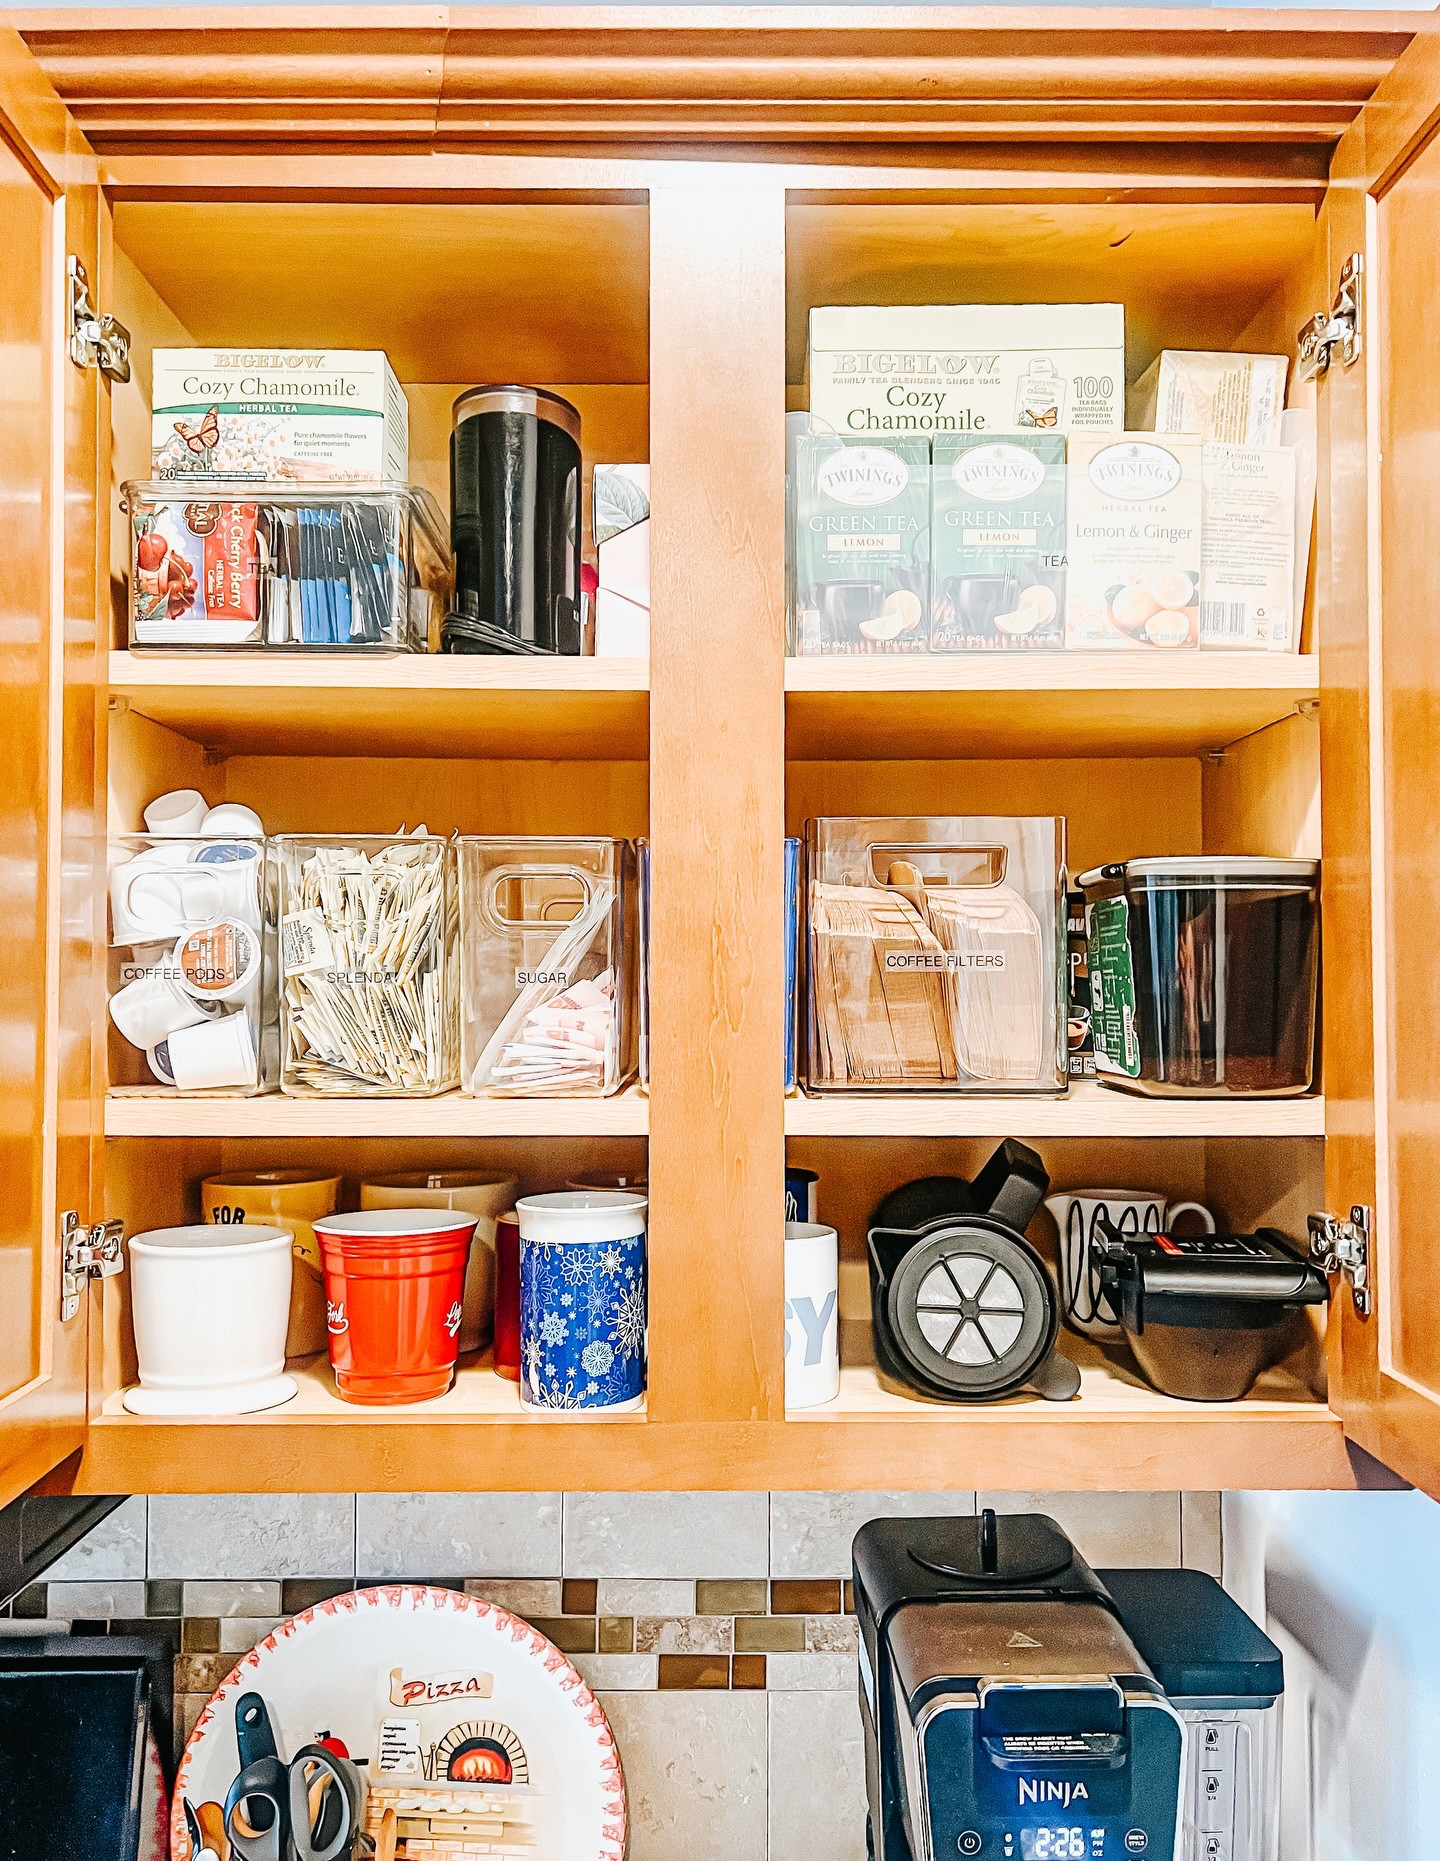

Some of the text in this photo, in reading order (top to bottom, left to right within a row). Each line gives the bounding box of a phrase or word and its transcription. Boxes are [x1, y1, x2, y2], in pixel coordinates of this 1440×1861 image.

[214, 354, 325, 368] BIGELOW
[832, 354, 1001, 374] BIGELOW
[183, 377, 357, 400] Cozy Chamomile
[1072, 376, 1114, 398] 100
[886, 385, 947, 413] Cozy
[239, 404, 298, 413] HERBAL TEA
[846, 408, 985, 430] Chamomile
[344, 432, 367, 440] flowers
[160, 468, 176, 480] 20
[960, 464, 1040, 483] TWININGS
[1095, 462, 1173, 482] TWININGS
[1232, 461, 1265, 474] Ginger
[824, 468, 903, 487] TWININGS
[809, 515, 920, 532] GREEN TEA
[944, 510, 1055, 527] GREEN TEA
[843, 538, 884, 547] LEMON
[979, 532, 1021, 541] LEMON
[1076, 524, 1192, 544] Lemon & Ginger
[228, 525, 244, 570] Cherry
[249, 562, 275, 574] TEA
[1042, 555, 1069, 567] TEA
[216, 560, 224, 590] HERBAL
[229, 572, 243, 609] Berry
[938, 632, 951, 642] 20
[952, 634, 965, 642] TEA
[966, 634, 985, 642] BAGS
[886, 955, 1004, 967] COFFEE FILTERS
[124, 968, 225, 980] COFFEE PODS
[327, 972, 393, 984] SPLENDA
[518, 972, 567, 984] SUGAR
[212, 1205, 246, 1224] FOR
[402, 1677, 481, 1706] Pizza
[1018, 1776, 1089, 1809] NINJA
[1035, 1827, 1085, 1857] 2:26
